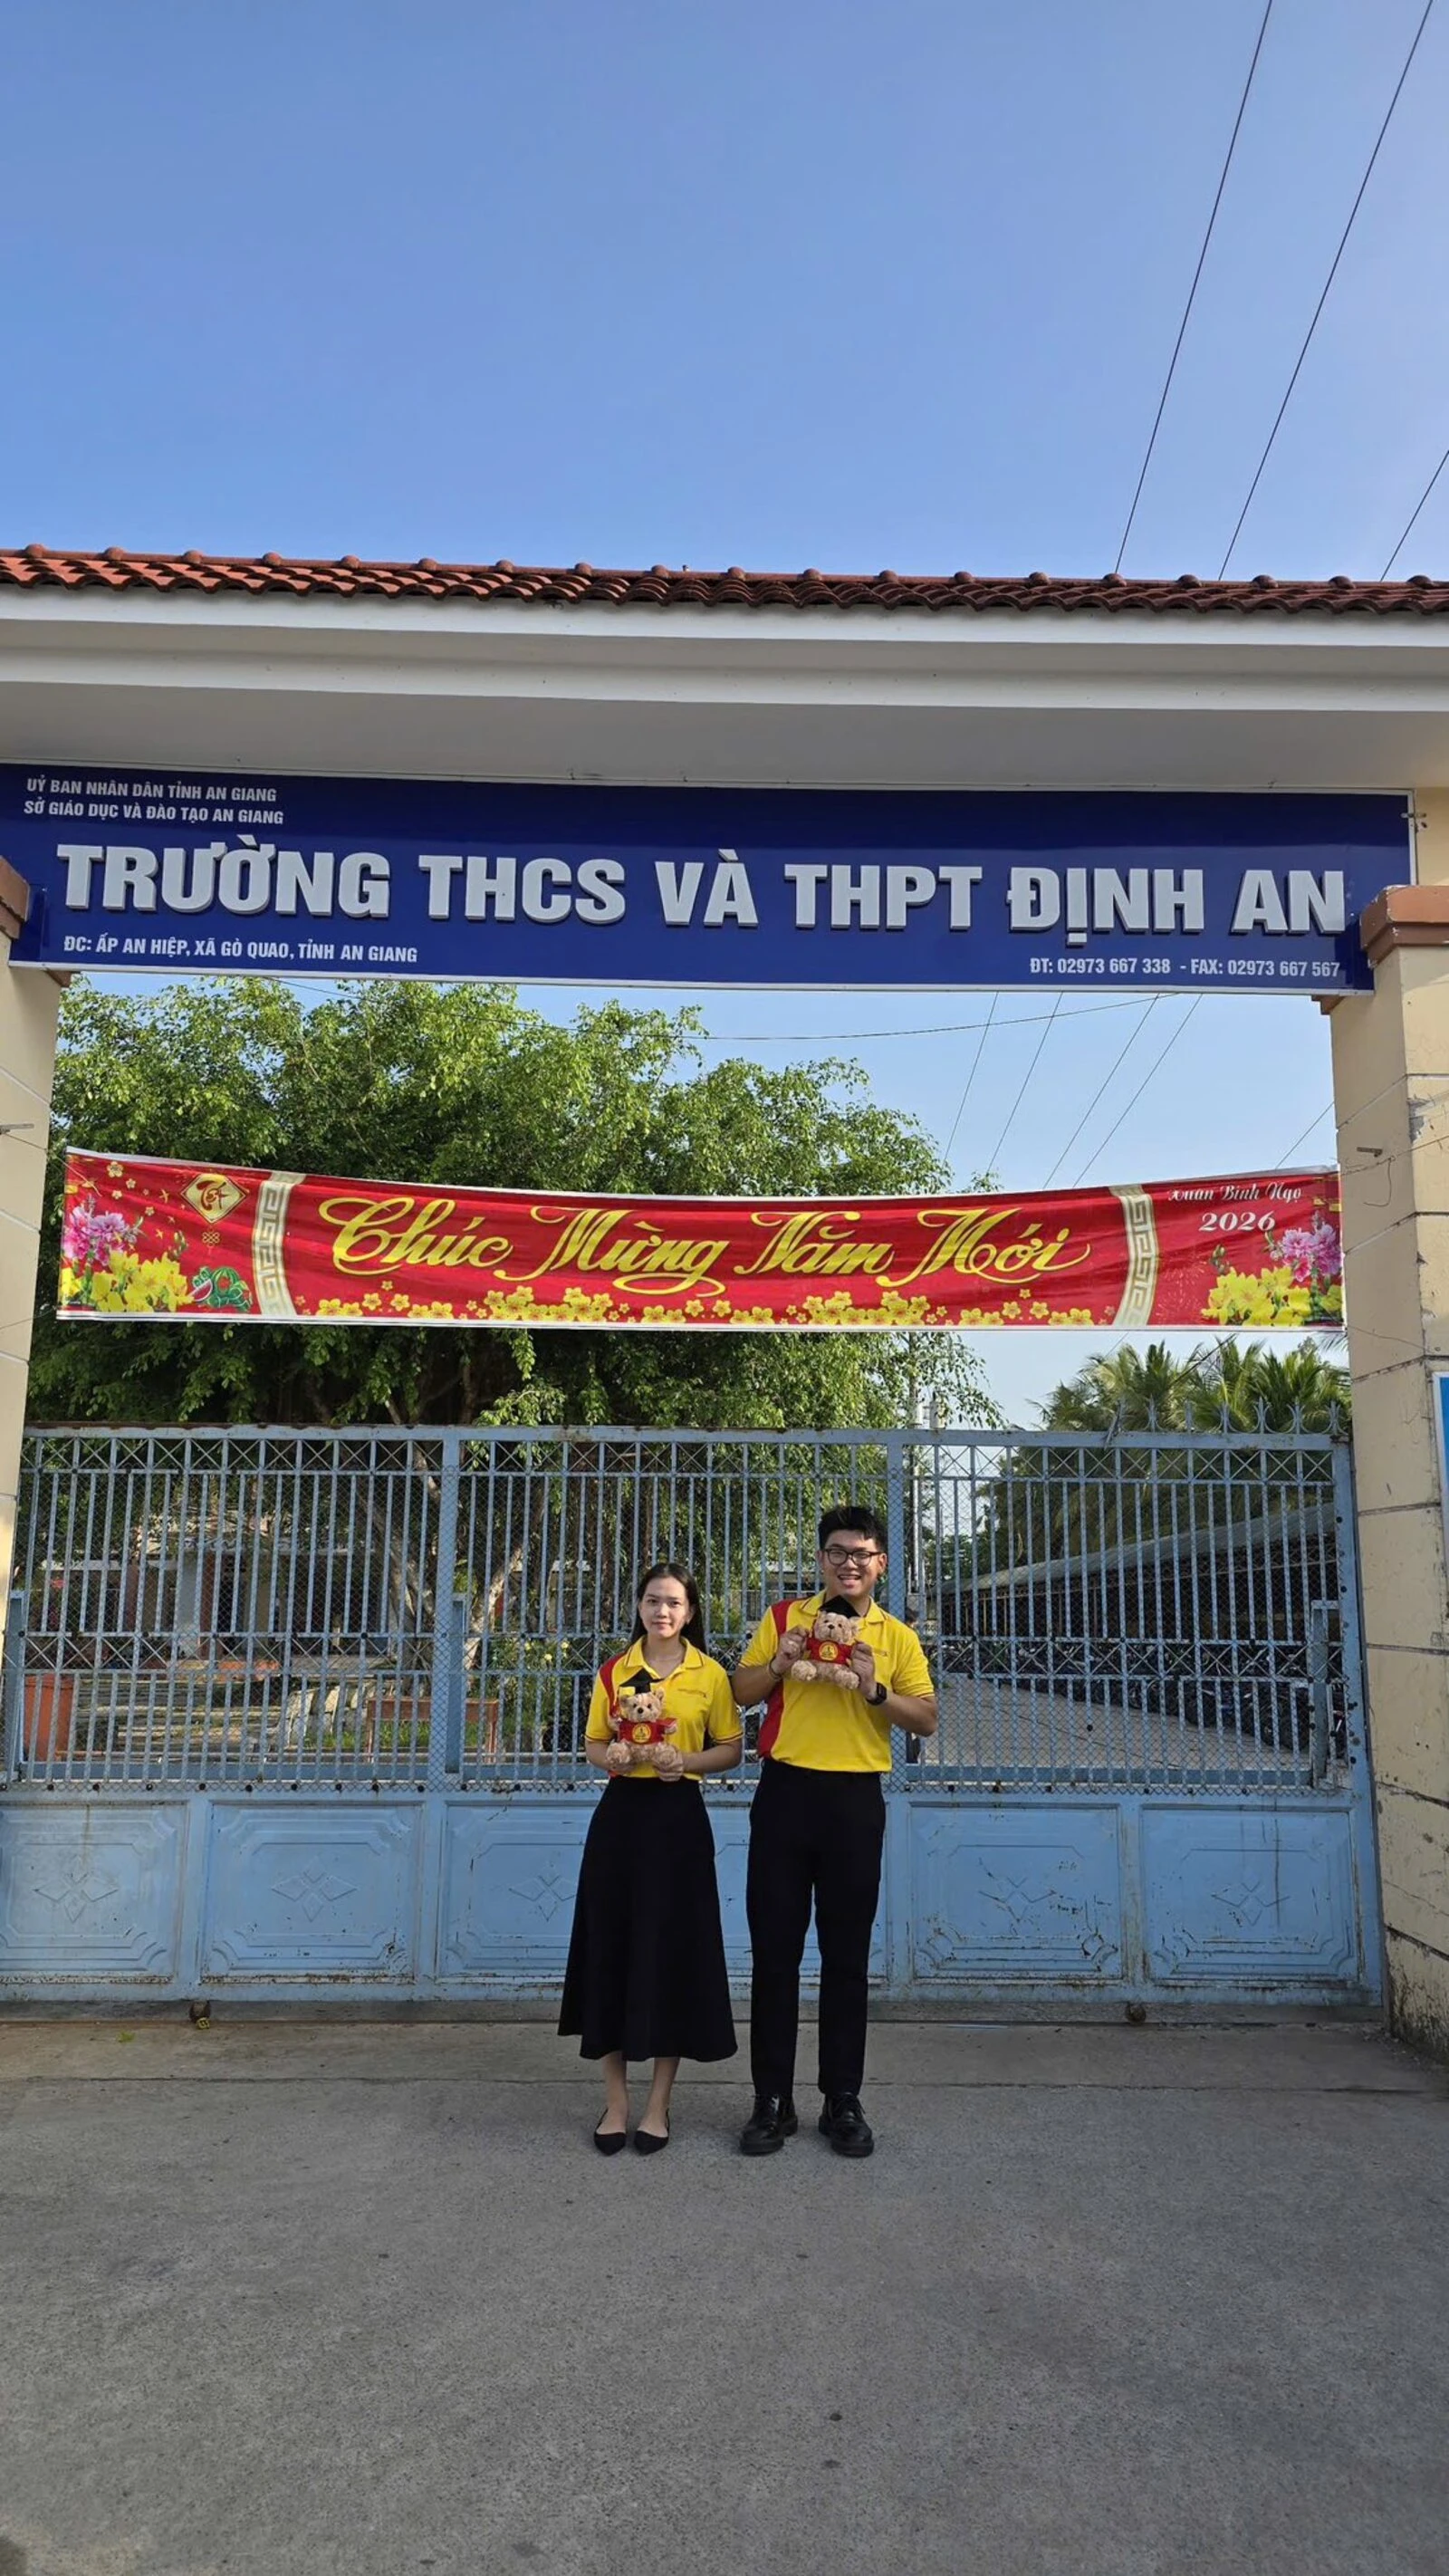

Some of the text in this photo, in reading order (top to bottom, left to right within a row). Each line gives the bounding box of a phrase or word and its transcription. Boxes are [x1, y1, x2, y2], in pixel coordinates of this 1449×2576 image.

[50, 779, 82, 794] BAN
[85, 780, 128, 796] NHÂN
[132, 781, 164, 798] DÂN
[168, 781, 202, 799] TỈNH
[206, 786, 227, 800] AN
[231, 787, 277, 802] GIANG
[24, 796, 284, 825] SỞ GIÁO DỤC VÀ ĐÀO TẠO AN GIANG
[56, 834, 1346, 947] TRƯỜNG THCS VÀ THPT ĐỊNH AN
[63, 932, 417, 963] ĐC: ẤP AN HIỆP, XÃ GÒ QUAO, TỈNH AN GIANG
[1030, 957, 1053, 974] ĐT:
[1057, 958, 1105, 974] 02973
[1109, 958, 1137, 974] 667
[1142, 958, 1171, 974] 338
[1191, 959, 1223, 975] FAX:
[1228, 960, 1275, 976] 02973
[1280, 961, 1308, 976] 667
[1311, 962, 1340, 977] 567
[1198, 1210, 1275, 1232] 2026
[318, 1197, 1090, 1297] Chúc Mừng Năm Mới
